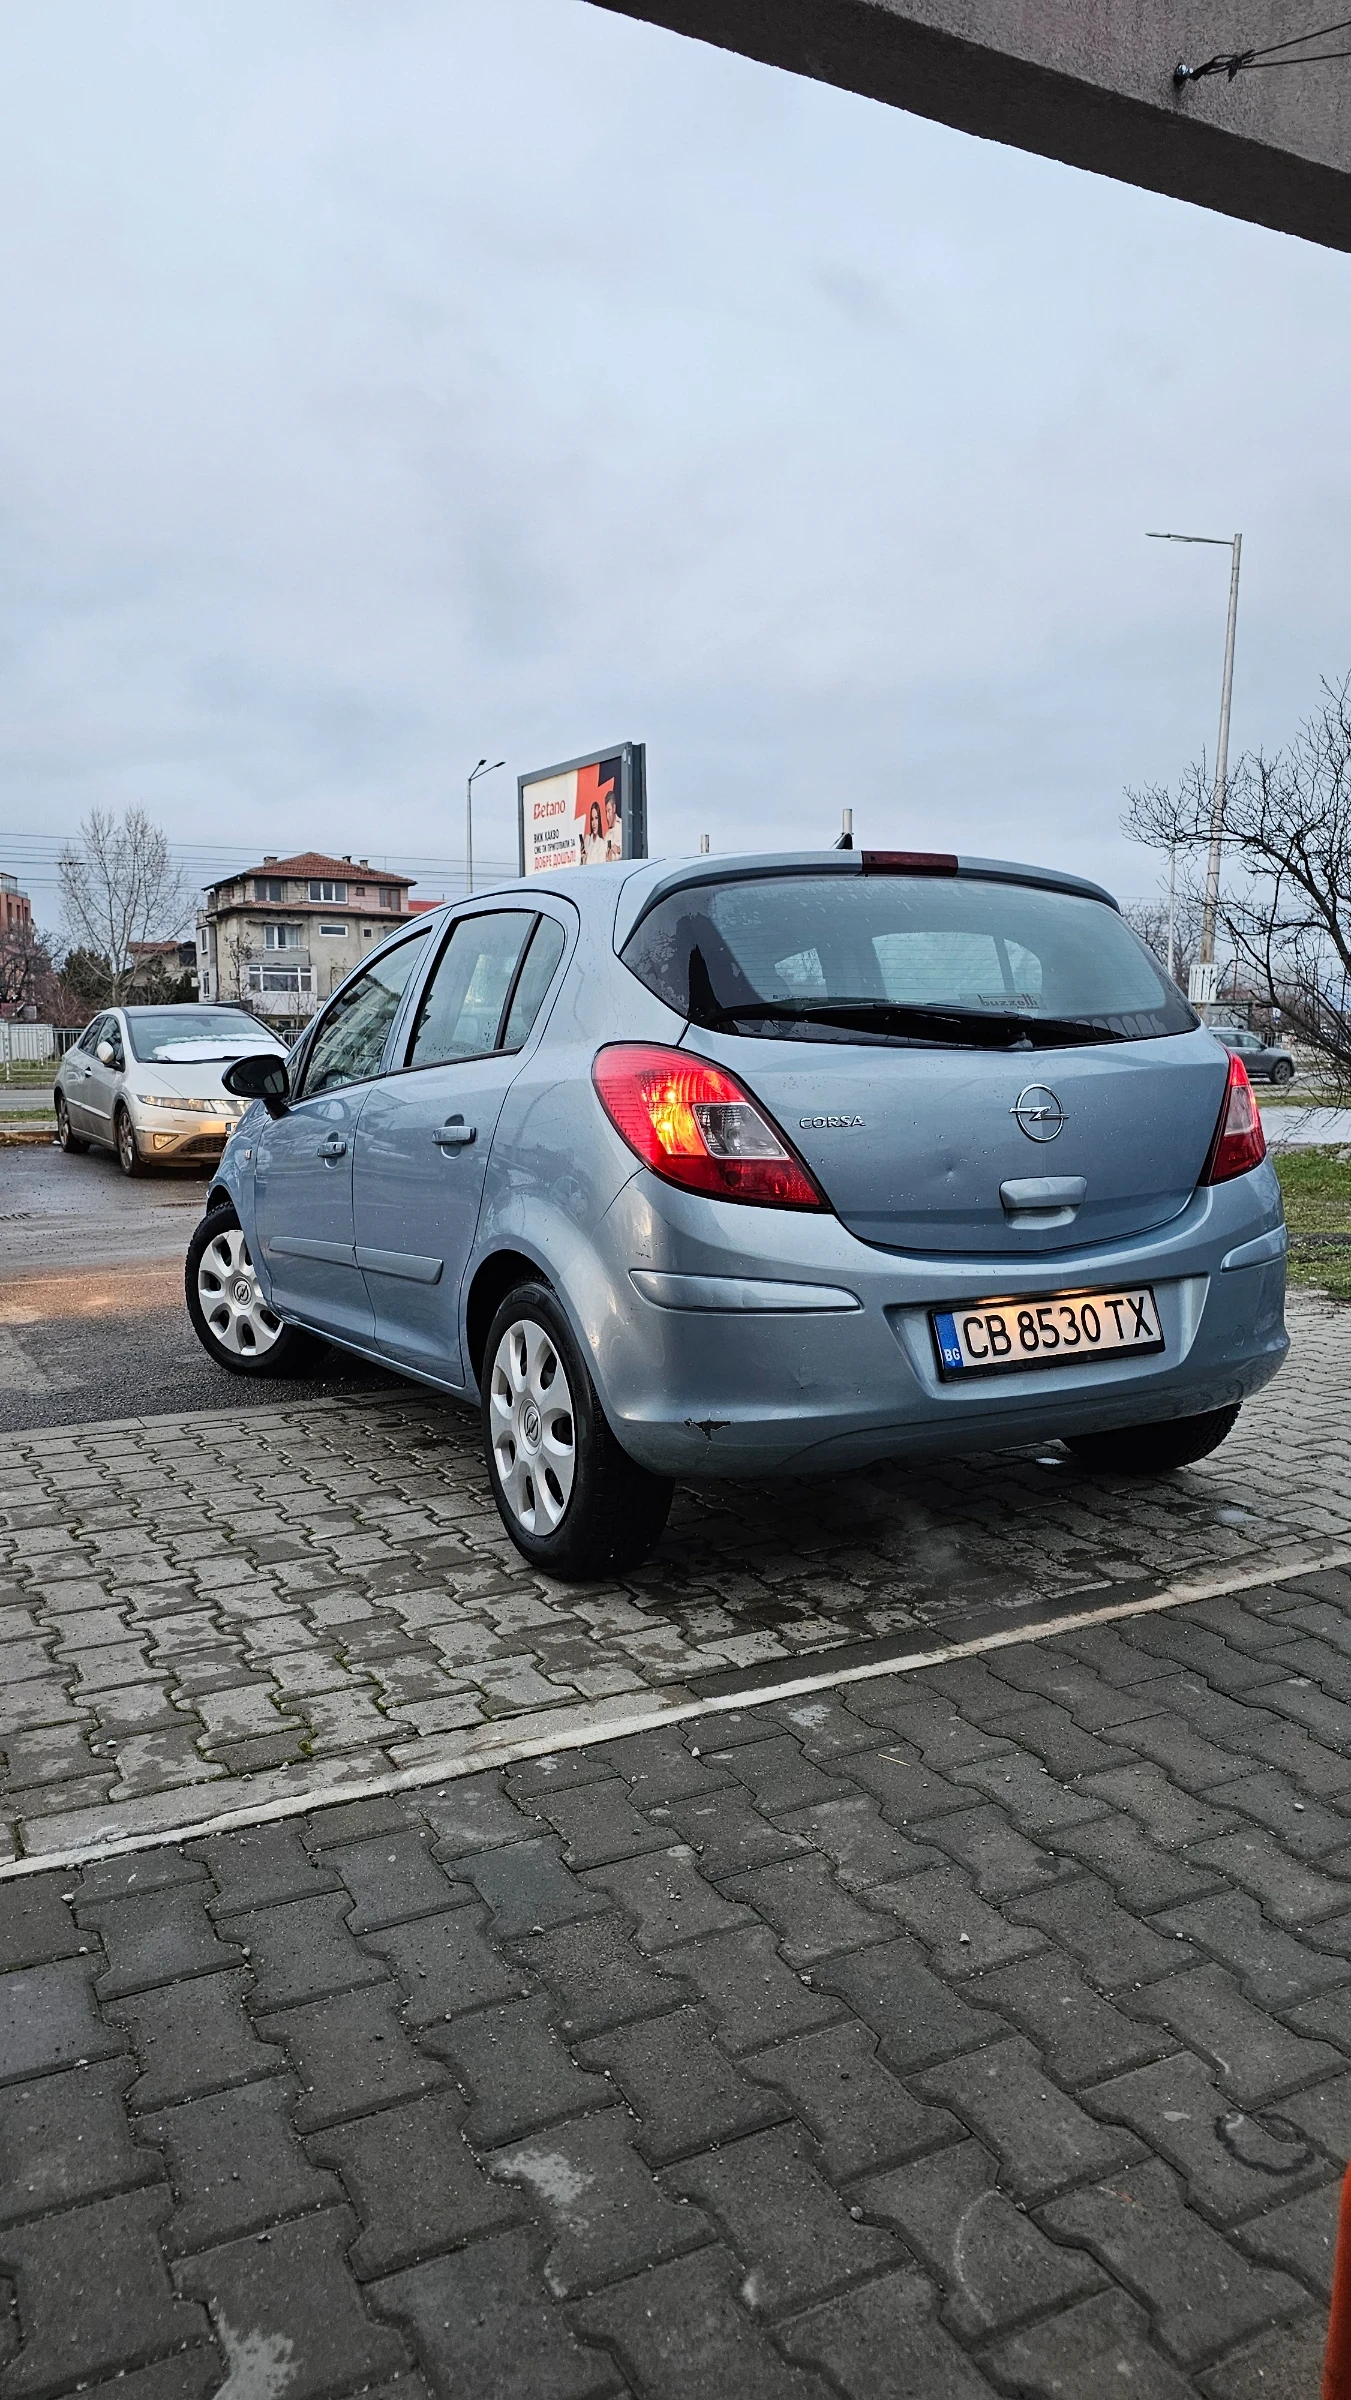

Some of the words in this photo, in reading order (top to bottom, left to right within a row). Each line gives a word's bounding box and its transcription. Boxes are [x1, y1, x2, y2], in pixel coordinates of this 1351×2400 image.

[534, 800, 566, 820] Betano
[544, 829, 559, 841] КАКВО
[534, 854, 552, 871] ДОБРЕ
[799, 1115, 866, 1129] CORSA
[962, 1315, 1012, 1358] CB
[1017, 1303, 1101, 1351] 8530
[1104, 1296, 1154, 1340] TX
[944, 1347, 961, 1362] BG
